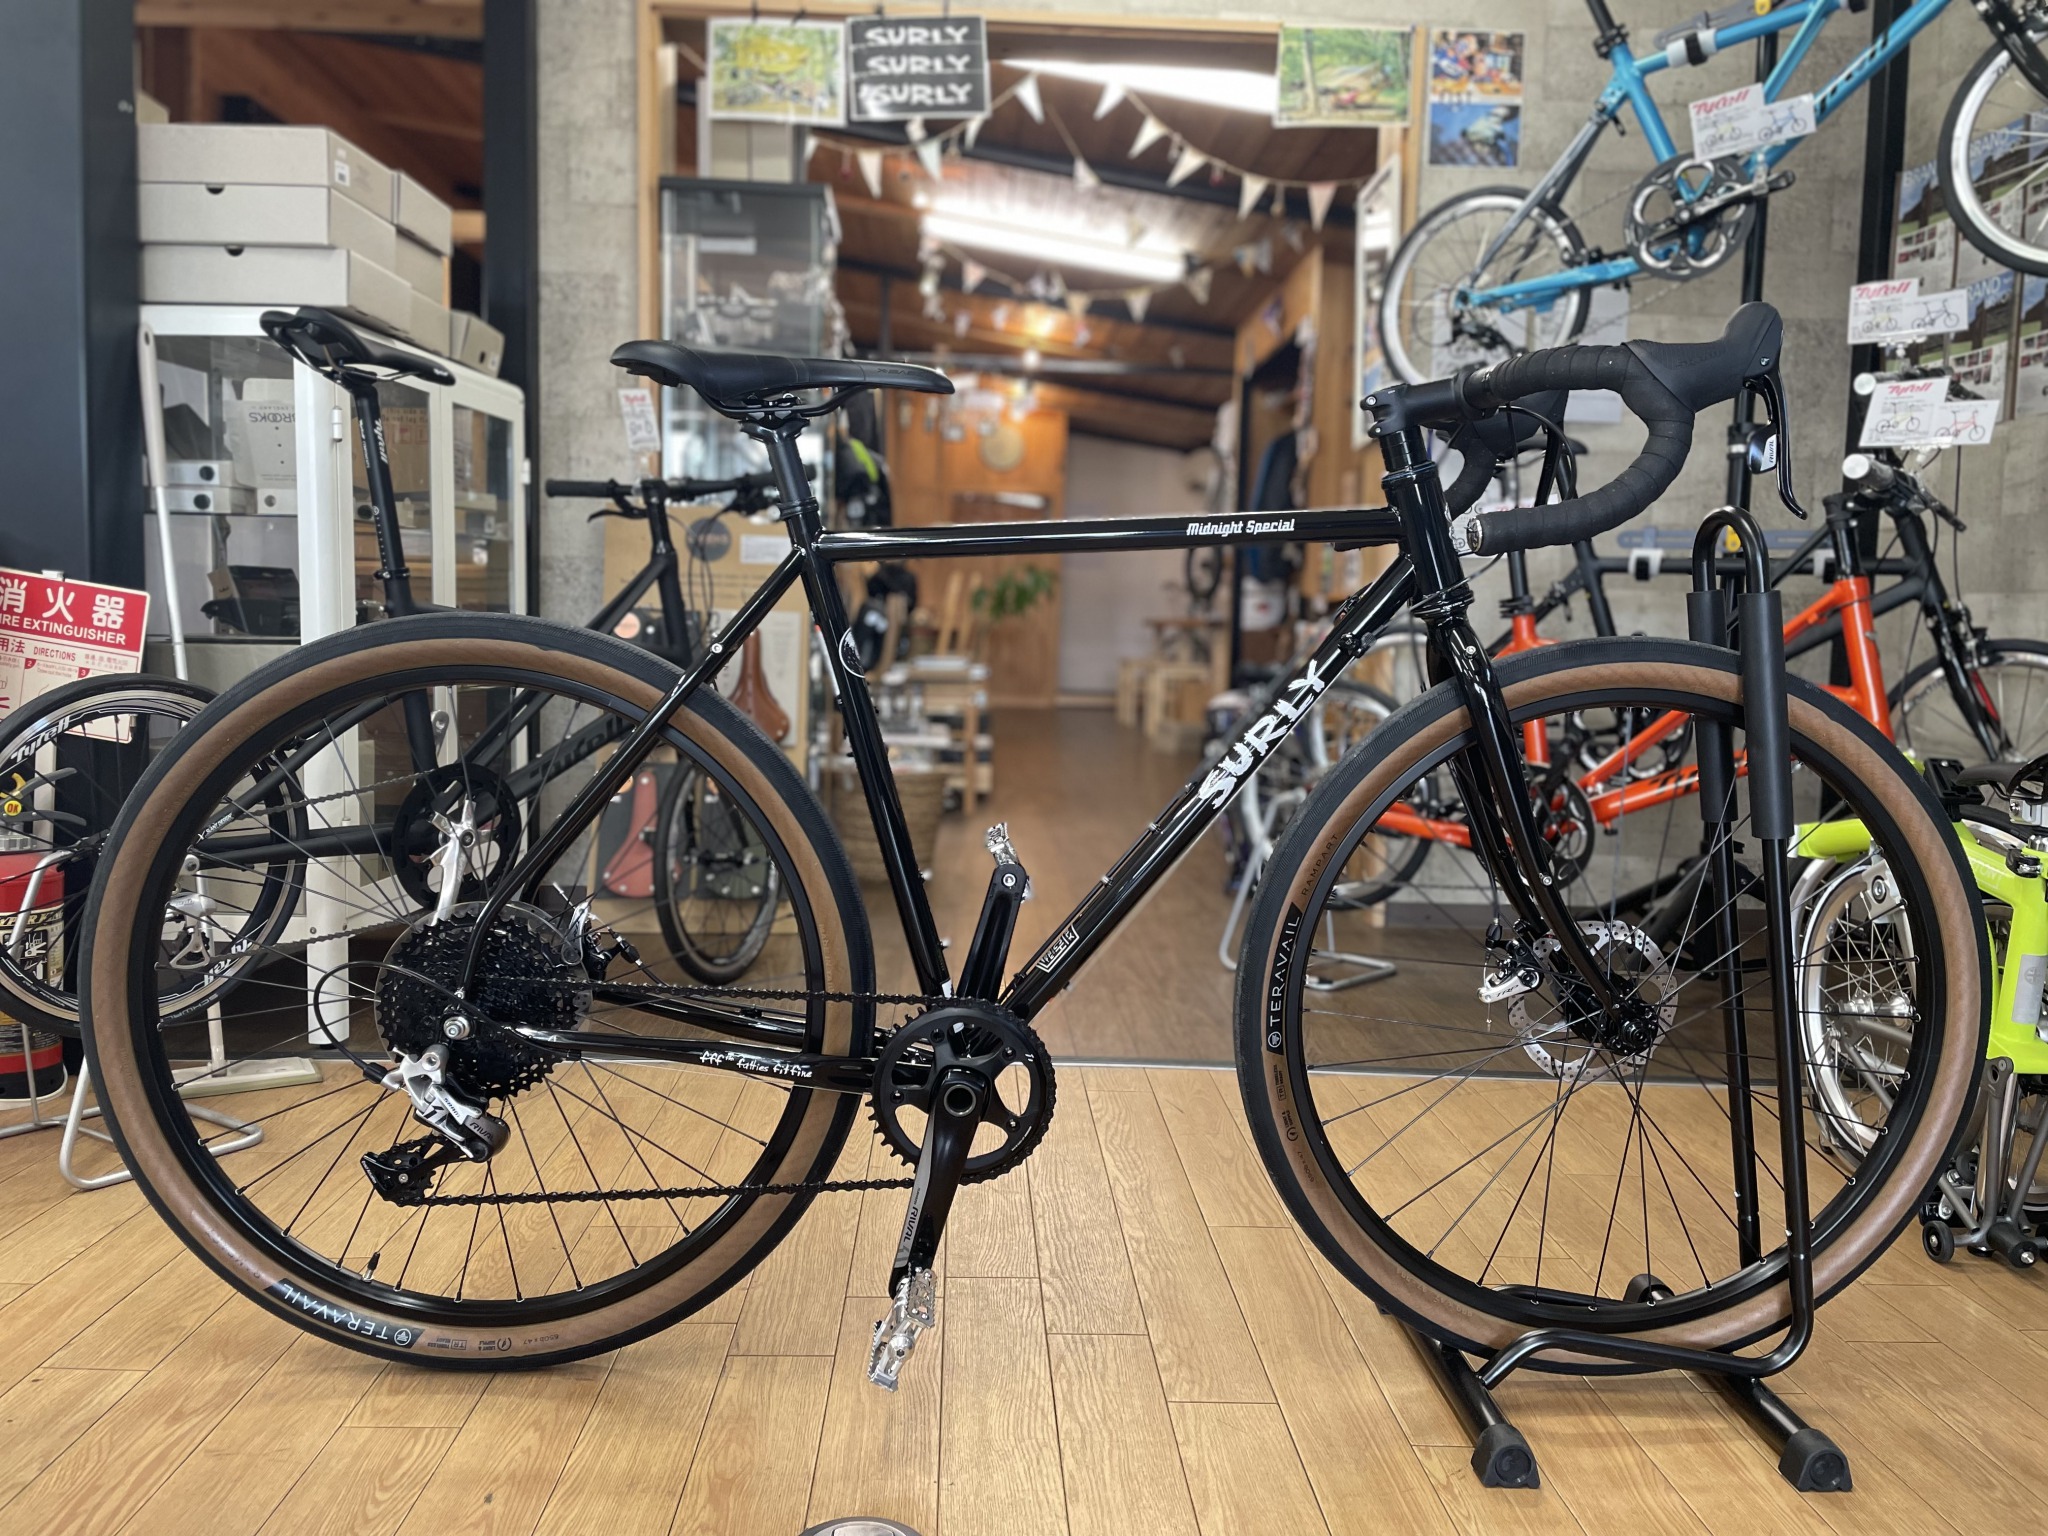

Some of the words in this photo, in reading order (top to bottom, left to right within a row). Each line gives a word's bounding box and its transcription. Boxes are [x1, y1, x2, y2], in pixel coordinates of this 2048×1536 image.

[865, 26, 969, 46] SURLY
[866, 55, 971, 74] SURLY
[869, 82, 973, 105] SURLY
[1186, 521, 1244, 537] Midnight
[1245, 519, 1296, 535] Special
[0, 576, 125, 629] 消火器
[23, 617, 126, 646] EXTINGUISHER
[34, 646, 76, 661] DIRECTIONS
[1198, 659, 1325, 809] SURLY
[7, 803, 19, 813] OK
[1302, 834, 1338, 896] RAMPART
[1269, 916, 1301, 1027] TERAVAIL
[903, 1206, 919, 1242] RIVAL
[283, 1283, 389, 1341] TERAVAIL
